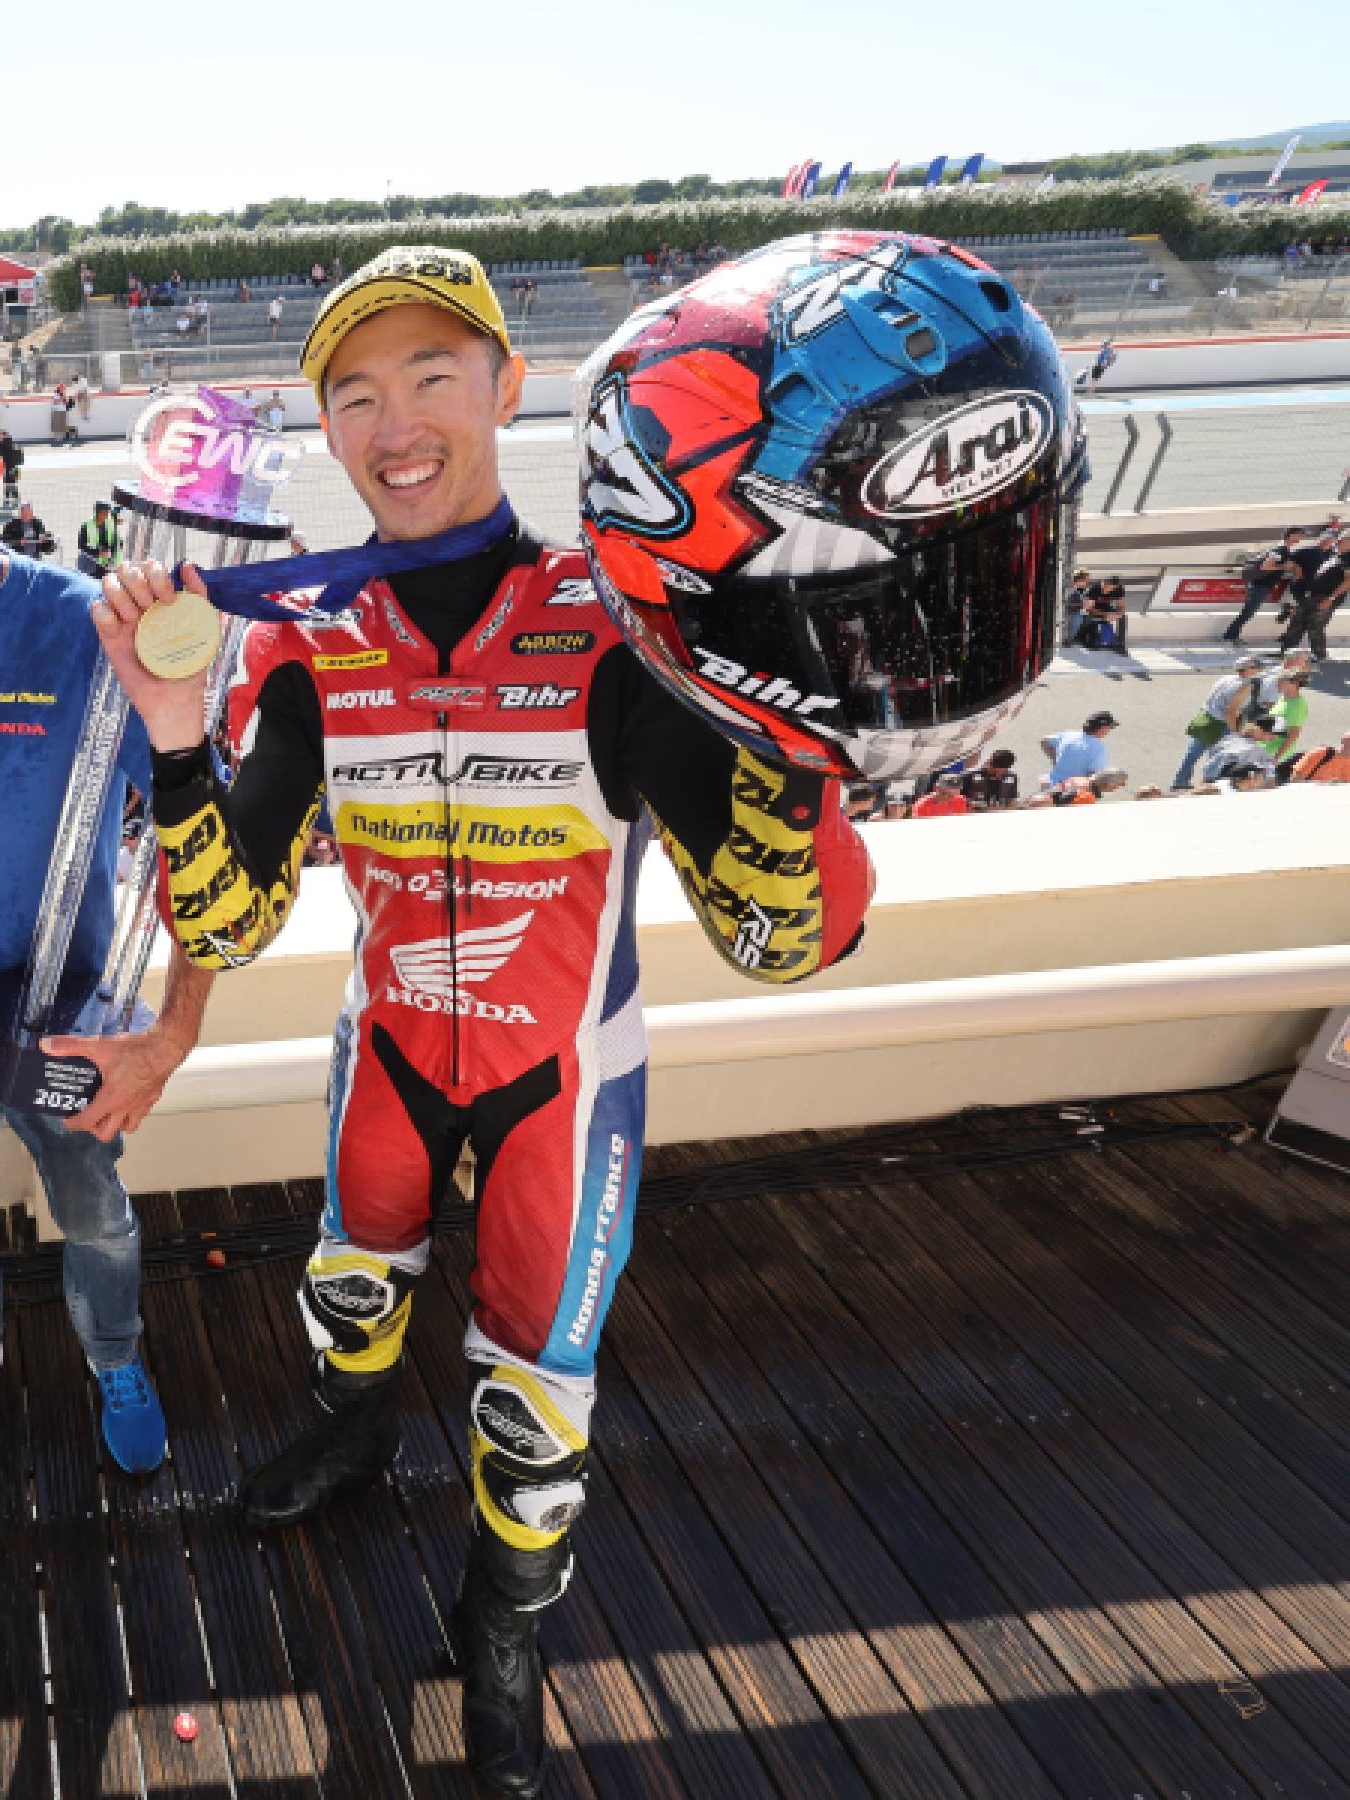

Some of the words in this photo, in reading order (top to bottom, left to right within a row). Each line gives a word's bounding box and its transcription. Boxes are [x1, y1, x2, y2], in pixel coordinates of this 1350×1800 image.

[156, 420, 304, 482] EWC
[886, 396, 1033, 511] Arai
[942, 457, 1014, 497] HELMET
[326, 688, 397, 710] MOTUL
[496, 685, 579, 709] Bihr
[692, 645, 842, 714] Bihr
[384, 984, 538, 1025] HONDA
[34, 1088, 88, 1112] 2024
[566, 1247, 608, 1346] Honda
[594, 1132, 627, 1244] France
